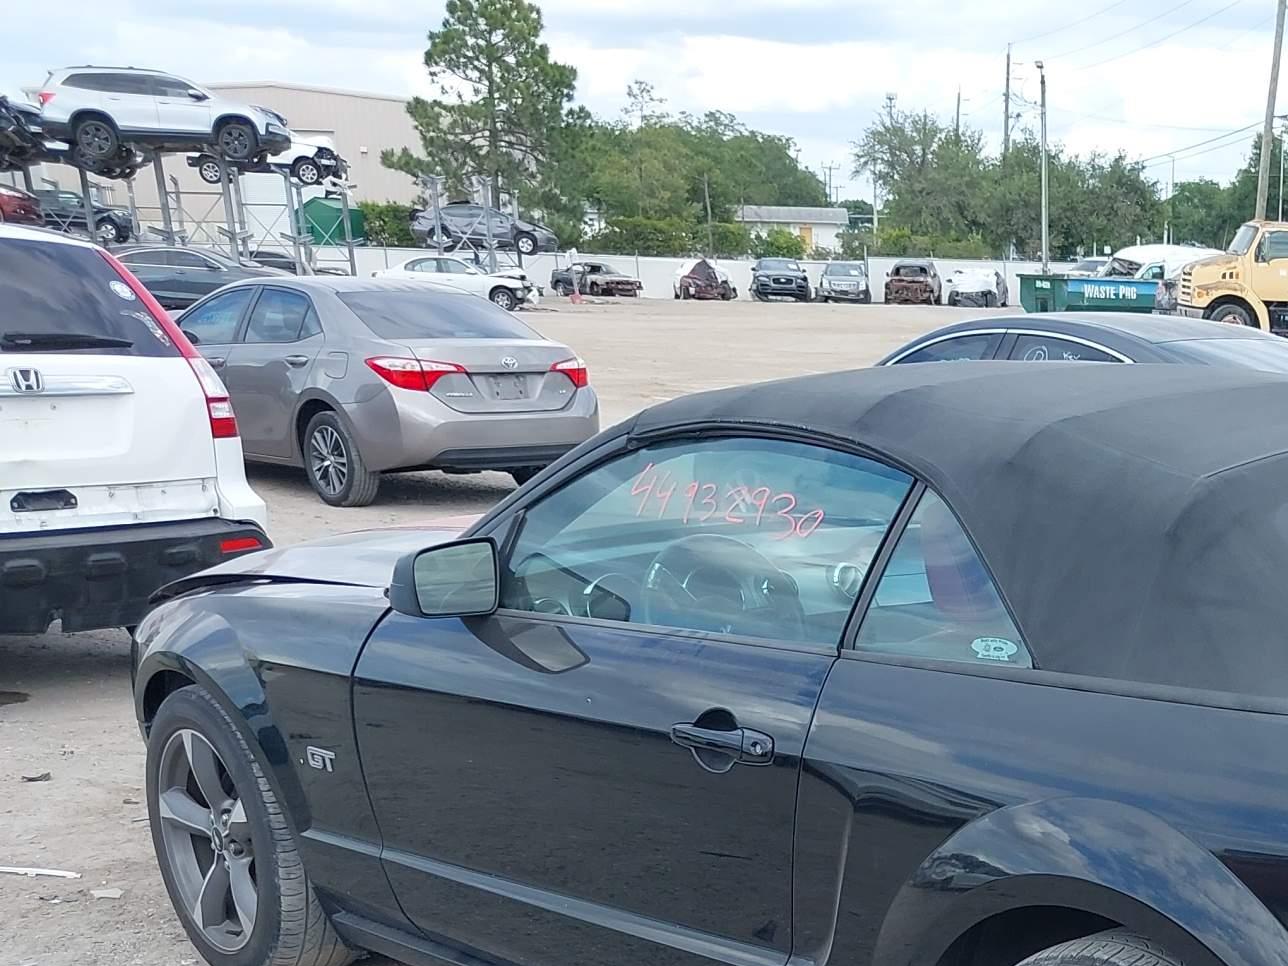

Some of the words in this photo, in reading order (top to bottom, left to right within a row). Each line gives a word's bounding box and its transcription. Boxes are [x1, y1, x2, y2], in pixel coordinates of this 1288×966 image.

[1083, 284, 1116, 299] WASTE
[631, 463, 825, 541] 44932930
[306, 745, 336, 772] GT
